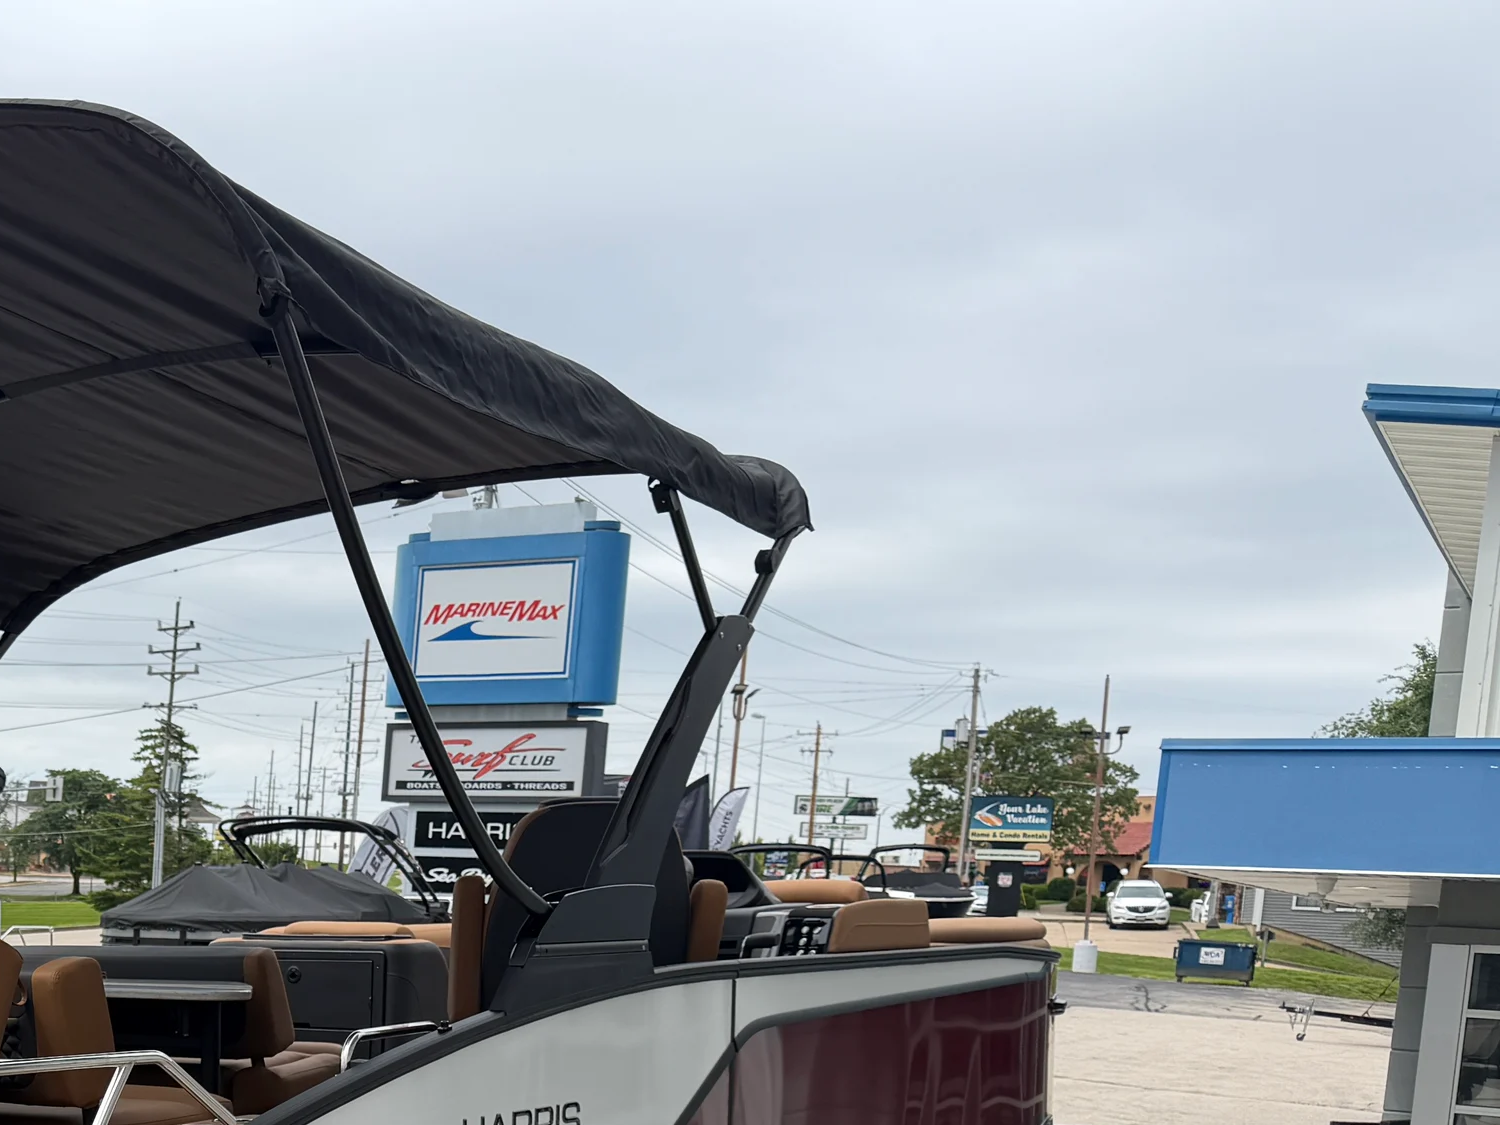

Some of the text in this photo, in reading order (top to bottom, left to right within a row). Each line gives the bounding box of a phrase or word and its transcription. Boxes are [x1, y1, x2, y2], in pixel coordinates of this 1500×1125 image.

[508, 755, 556, 766] CLUB
[406, 782, 567, 791] BOATS OARDS THREADS
[998, 803, 1049, 815] Your Lake
[1006, 814, 1048, 824] Vacation
[427, 821, 517, 840] HARI
[714, 811, 734, 847] YACHTS
[420, 867, 458, 883] Sea
